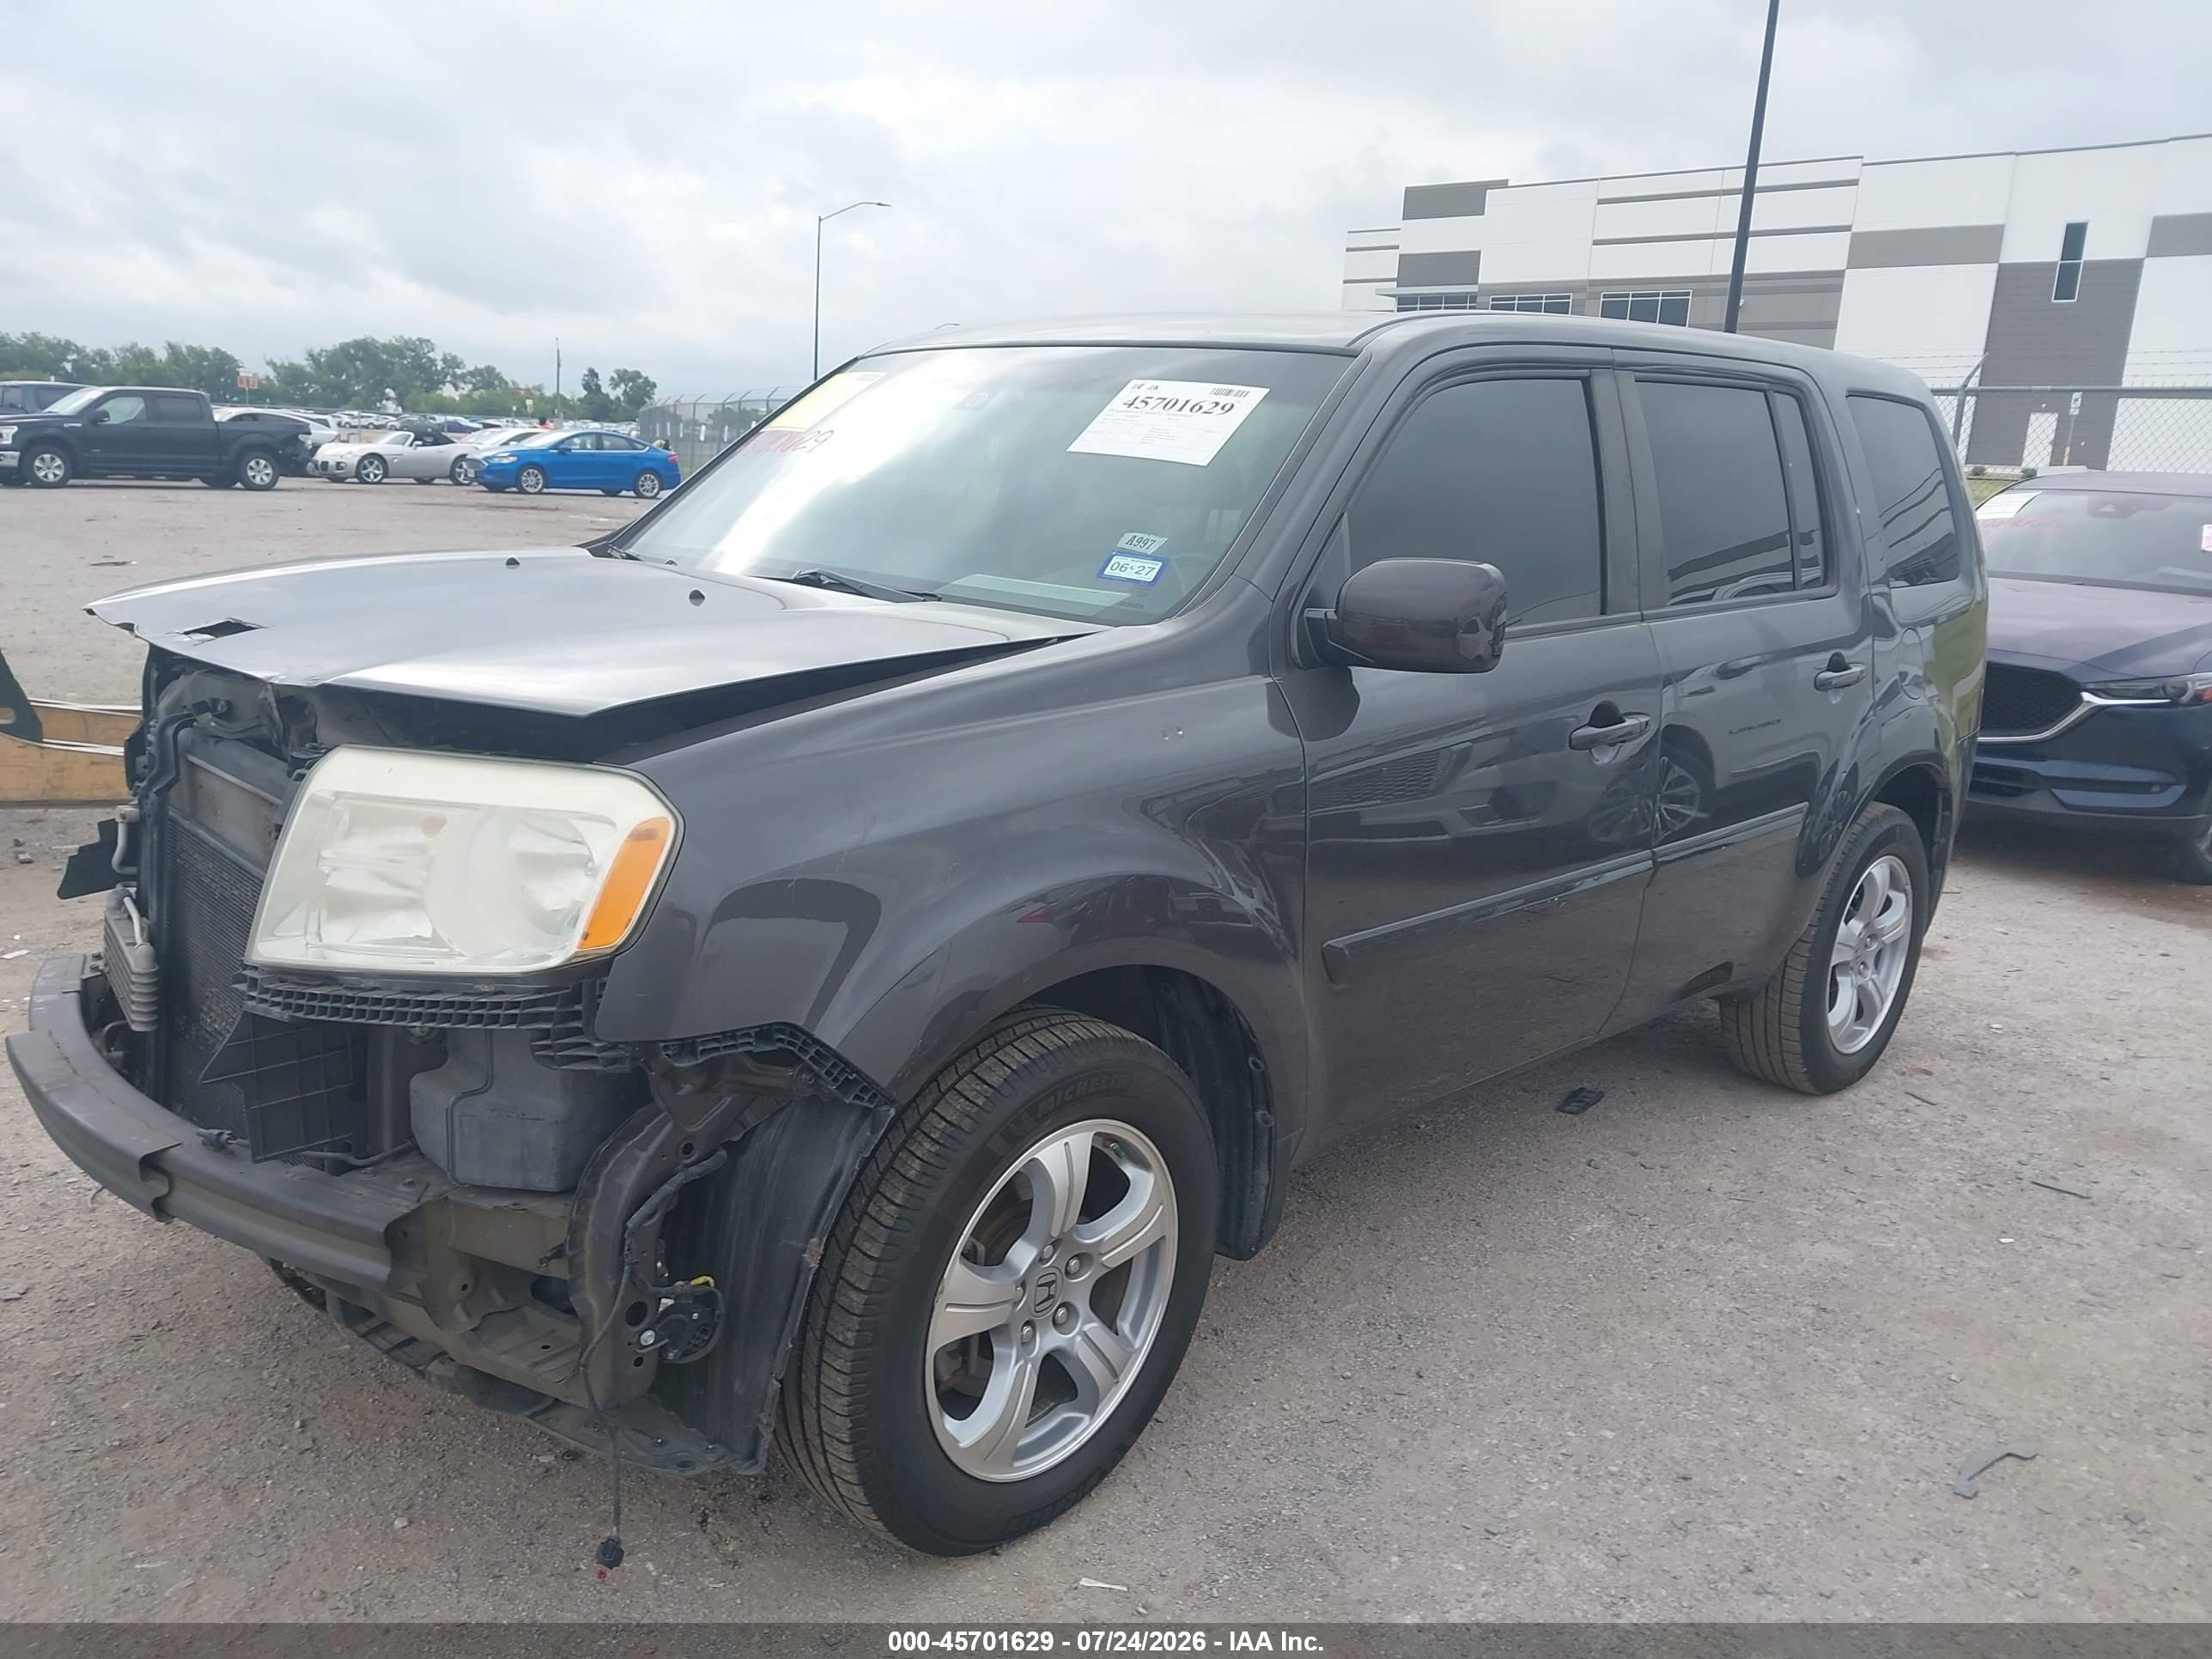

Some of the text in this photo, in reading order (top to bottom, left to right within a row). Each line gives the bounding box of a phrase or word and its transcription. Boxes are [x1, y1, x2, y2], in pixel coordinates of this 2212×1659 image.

[1123, 395, 1235, 416] 45701629
[1125, 535, 1156, 550] A997
[1109, 562, 1129, 573] 06
[1133, 565, 1156, 576] 27
